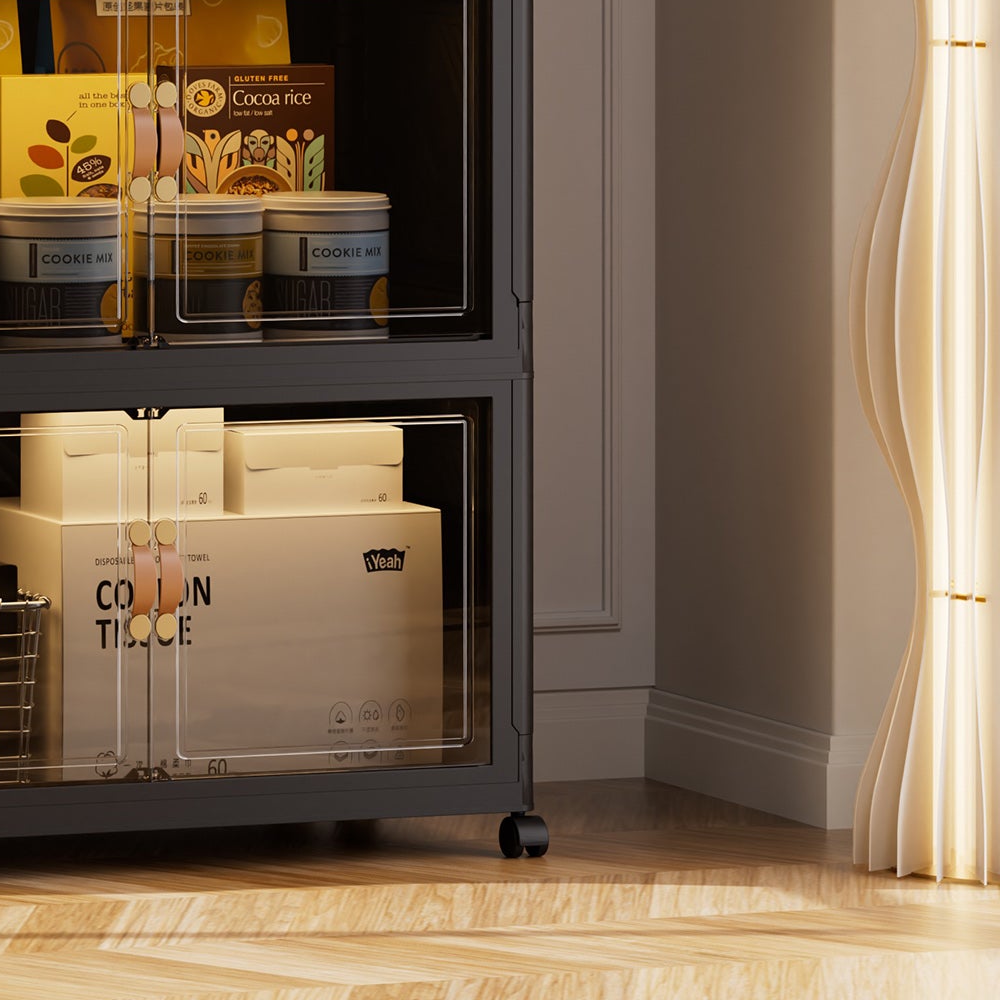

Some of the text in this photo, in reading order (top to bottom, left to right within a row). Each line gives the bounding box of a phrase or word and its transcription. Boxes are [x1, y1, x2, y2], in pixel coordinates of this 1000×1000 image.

[232, 88, 312, 106] Cocoa rice
[187, 102, 223, 116] ORGANIC
[41, 252, 113, 265] COOKIE MIX
[312, 246, 382, 258] COOKIE MIX
[198, 491, 208, 505] 60
[378, 492, 387, 502] 60
[187, 554, 210, 562] TOWEL
[366, 552, 402, 570] iYeah
[208, 758, 228, 776] 60
